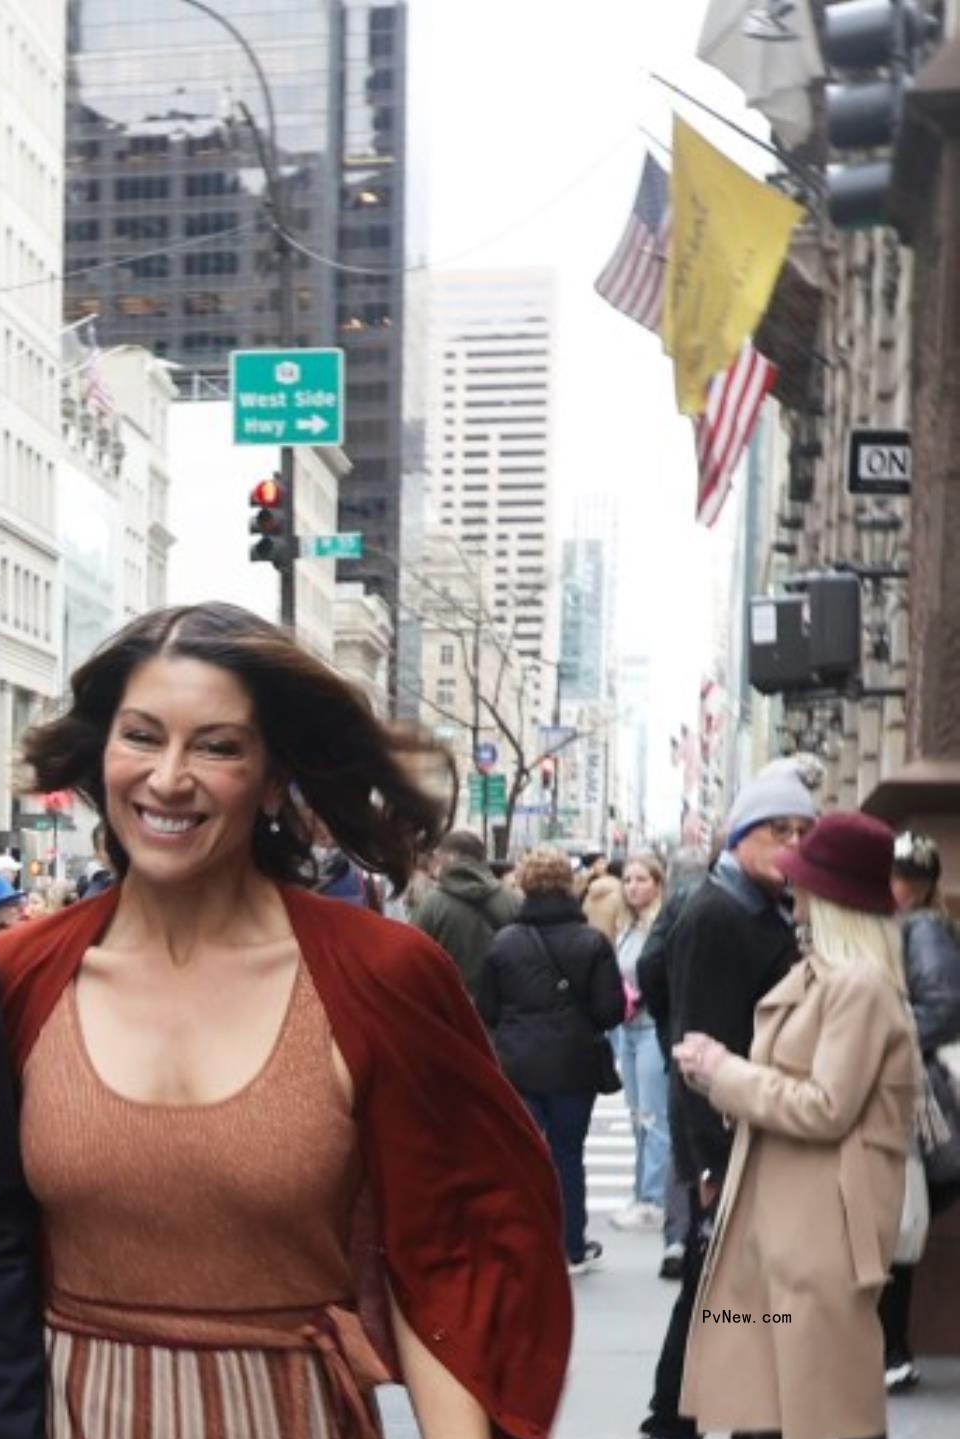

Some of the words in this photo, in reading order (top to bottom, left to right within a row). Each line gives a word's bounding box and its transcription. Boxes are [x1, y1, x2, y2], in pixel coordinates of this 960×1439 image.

[240, 391, 285, 408] West
[294, 390, 336, 408] Side
[244, 416, 286, 438] Hwy
